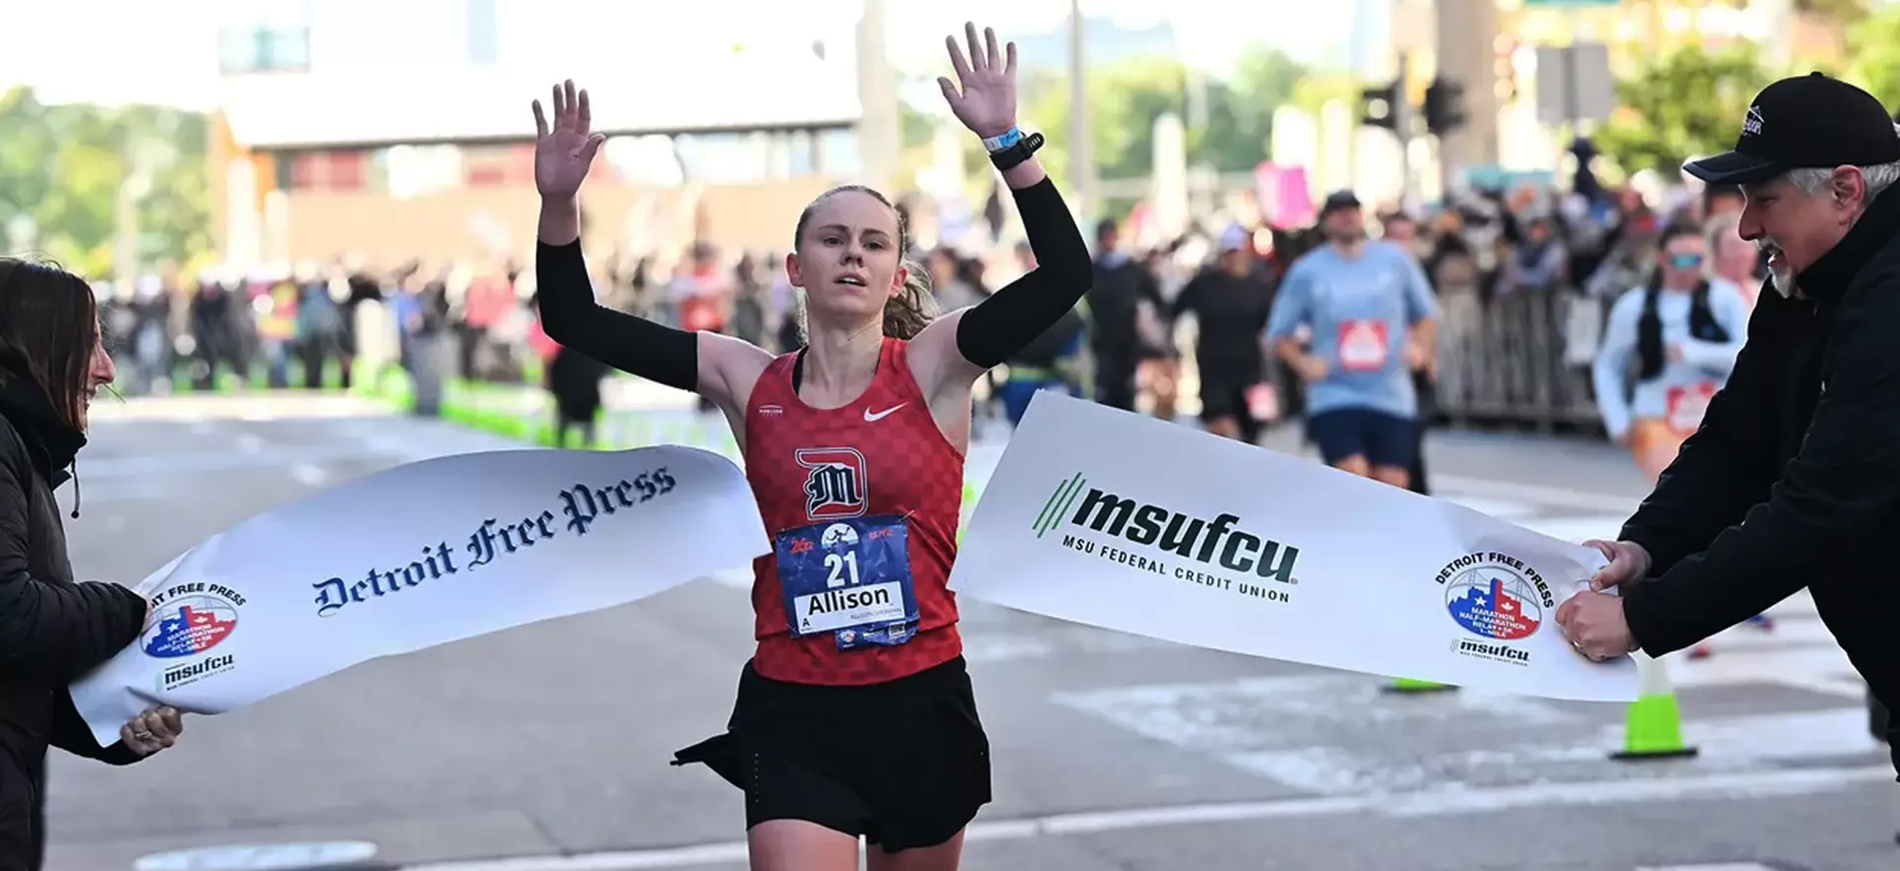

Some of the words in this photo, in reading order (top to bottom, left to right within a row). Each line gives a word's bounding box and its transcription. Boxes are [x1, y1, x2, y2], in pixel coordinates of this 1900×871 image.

[312, 541, 458, 618] Detroit
[466, 509, 558, 572] Free
[558, 466, 677, 537] Press
[1071, 488, 1299, 584] msufcu
[824, 550, 860, 589] 21
[1062, 535, 1096, 554] MSU
[1100, 546, 1167, 575] FEDERAL
[1174, 567, 1232, 591] CREDIT
[1239, 583, 1290, 603] UNION
[1435, 552, 1484, 585] DETROIT
[1489, 552, 1525, 571] FREE
[1524, 567, 1555, 608] PRESS
[167, 582, 205, 598] FREE
[208, 583, 247, 607] PRESS
[808, 588, 889, 616] Allison
[802, 618, 811, 628] A
[1471, 607, 1516, 622] MARATHON
[1460, 641, 1529, 662] msufcu
[164, 654, 233, 685] msufcu
